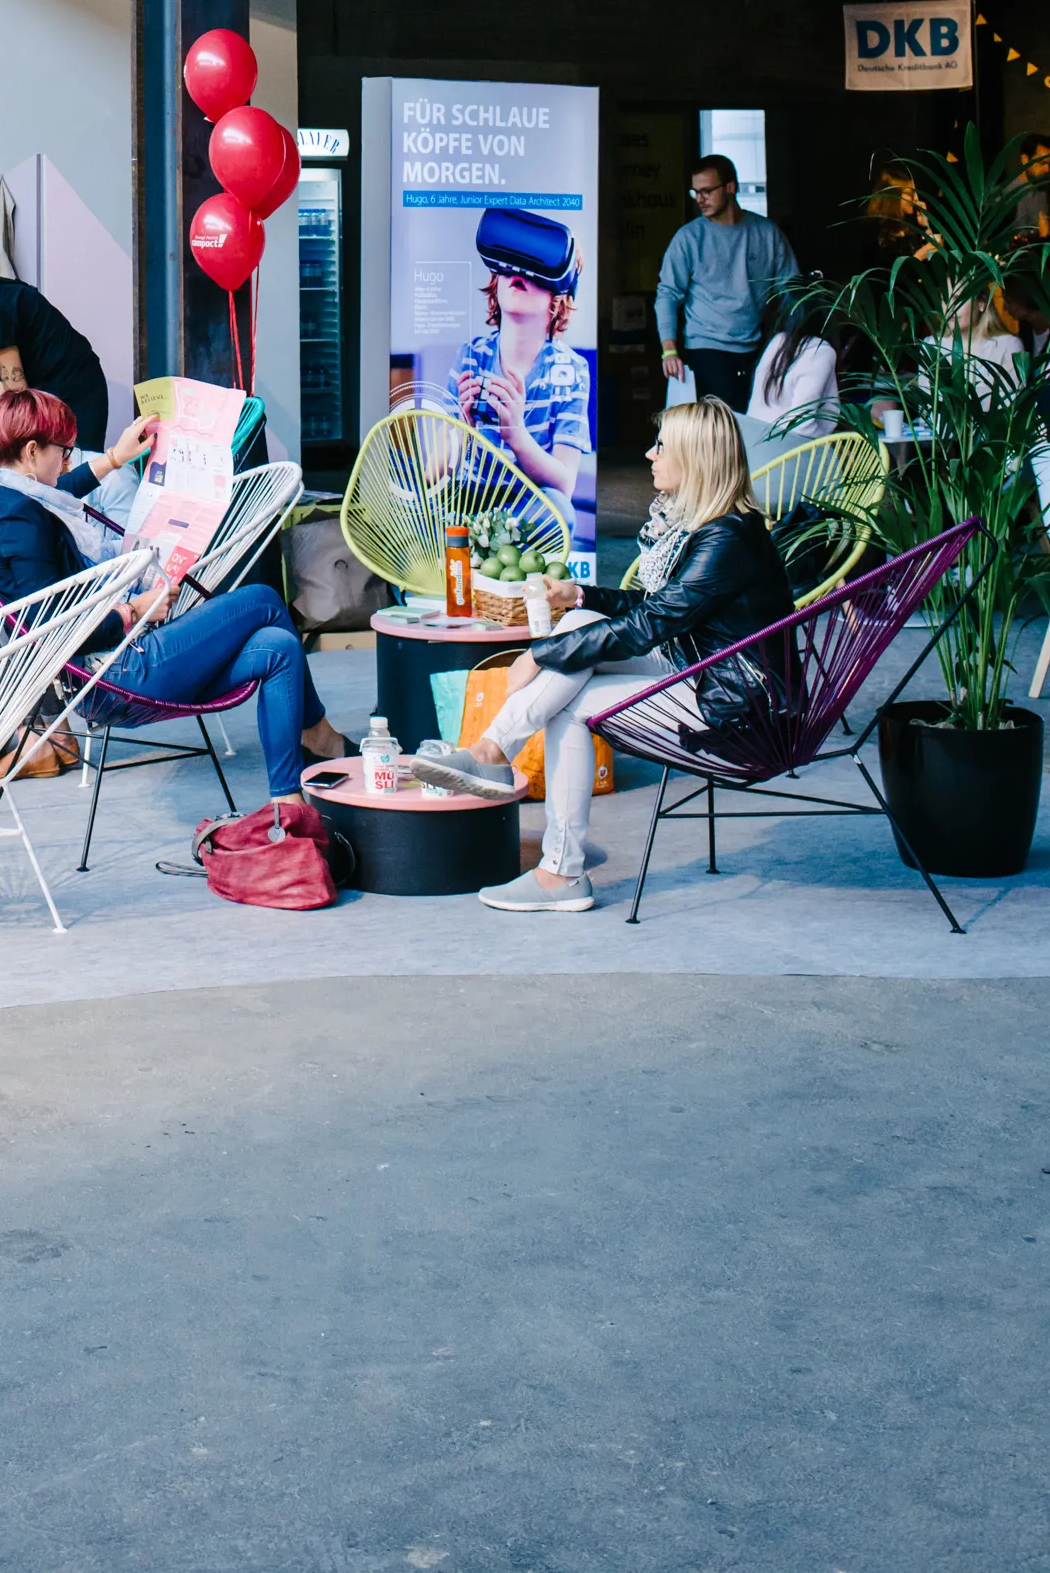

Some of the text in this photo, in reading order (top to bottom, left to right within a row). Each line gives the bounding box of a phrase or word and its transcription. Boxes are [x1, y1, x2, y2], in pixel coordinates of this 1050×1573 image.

[856, 17, 960, 58] DKB
[858, 61, 958, 72] Deutsche Kreditbank AG
[403, 98, 550, 129] FÜR SCHLAUE
[403, 128, 525, 157] KÖPFE VON
[402, 161, 506, 185] MORGEN.
[406, 194, 580, 207] Hugo, 6 Jahre, Junior Expert Data Architect 2040
[414, 268, 444, 285] Hugo
[568, 561, 591, 579] KB
[374, 770, 394, 781] MÜ
[375, 779, 394, 790] SLI
